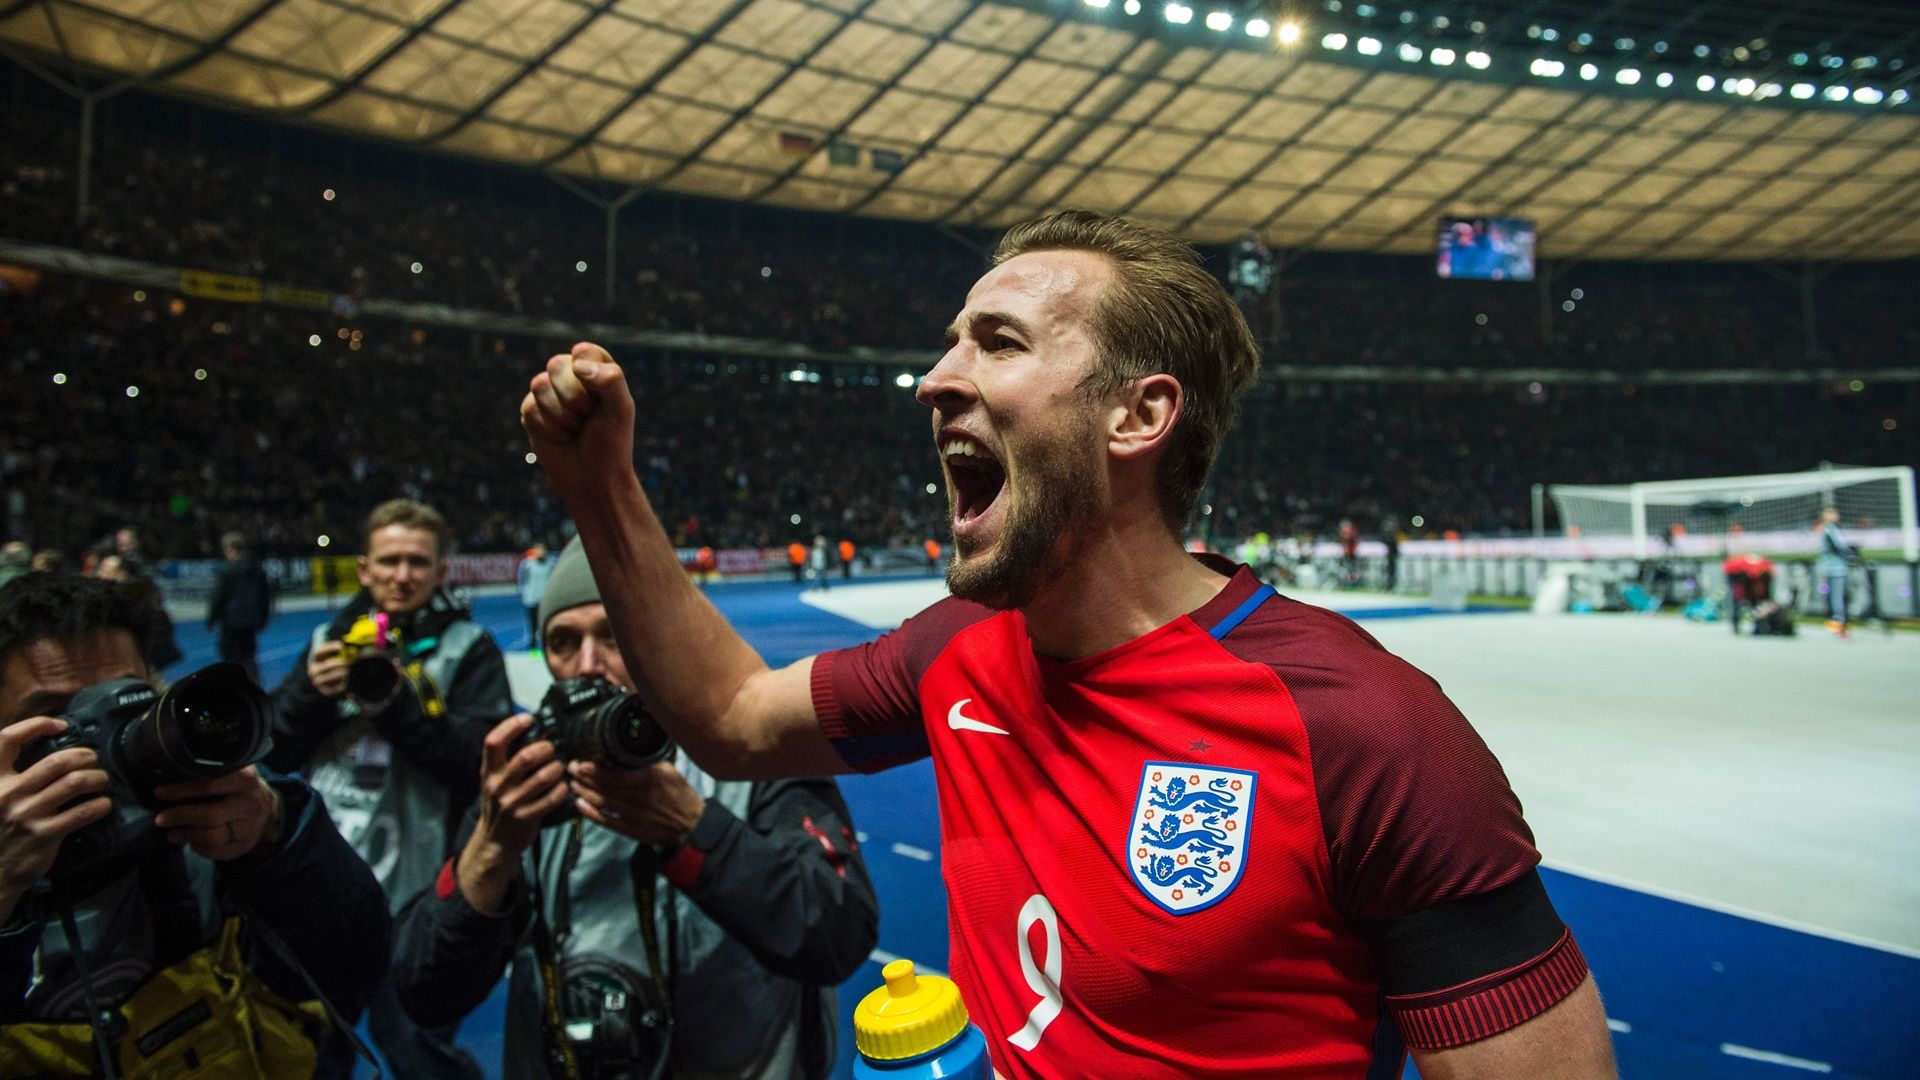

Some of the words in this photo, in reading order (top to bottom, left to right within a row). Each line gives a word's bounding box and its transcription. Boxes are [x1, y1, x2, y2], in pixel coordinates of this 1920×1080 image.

[119, 690, 153, 705] Nikon
[569, 688, 598, 704] Nikon
[1007, 894, 1063, 1051] 9
